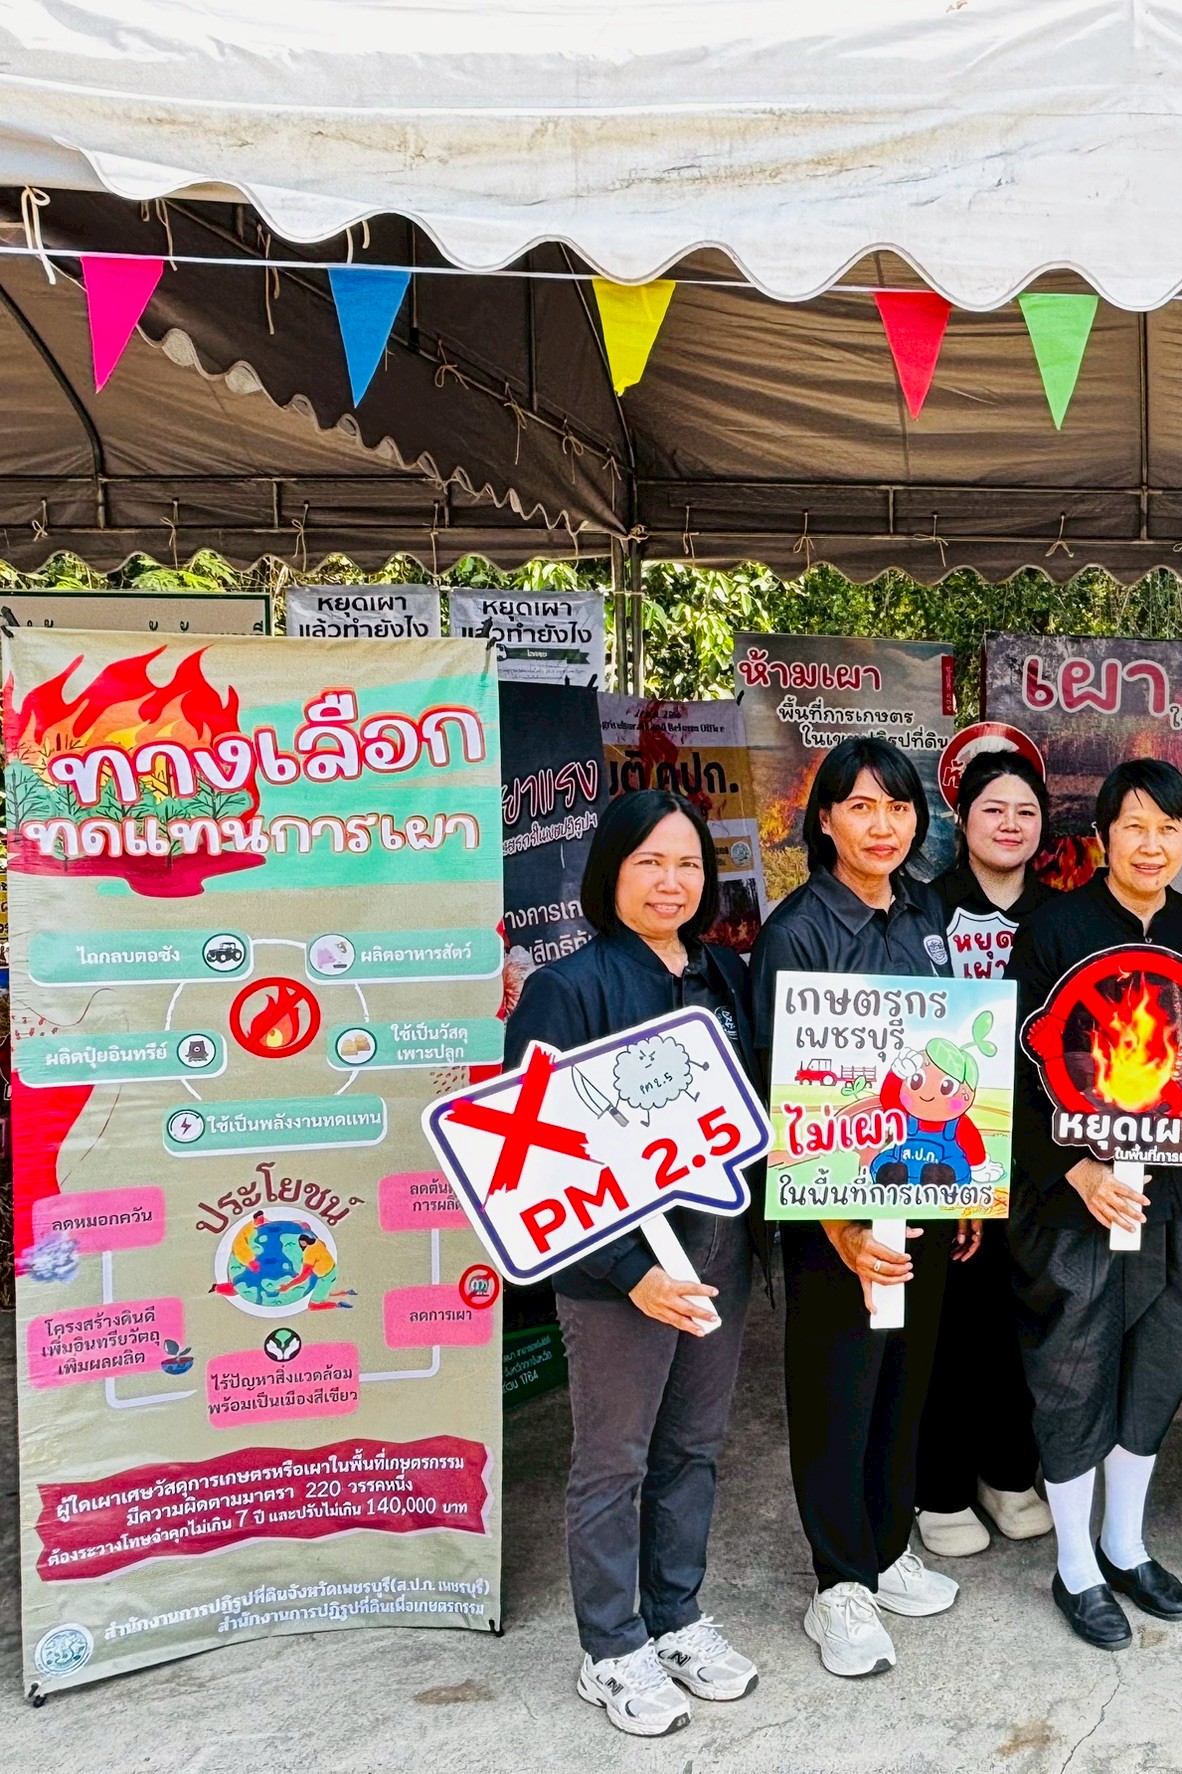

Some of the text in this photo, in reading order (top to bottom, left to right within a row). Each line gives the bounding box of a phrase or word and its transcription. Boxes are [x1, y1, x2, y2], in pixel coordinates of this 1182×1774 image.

[318, 596, 407, 619] หยุดเผา
[483, 600, 572, 622] หยุดเผา
[300, 615, 429, 637] แล้วทำยังไง
[739, 649, 881, 691] ห้ามเผา
[1023, 655, 1169, 715] เผา
[779, 697, 913, 724] พื้นที่การเกษตร
[48, 688, 486, 806] ทางเลือก
[22, 813, 480, 857] ทดแทนการเผา
[77, 945, 180, 965] ไถกลบตอซัง
[361, 942, 472, 963] ผลิตอาหารสัตว์
[785, 987, 947, 1019] เกษตรกร
[390, 1023, 468, 1044] ใช้เป็นวัสดุ
[796, 1018, 905, 1063] เพชรบุรี
[45, 1042, 168, 1069] ผลิตปุ๋ยอินทรีย์
[397, 1045, 464, 1063] เพาะปลูก
[207, 1112, 381, 1133] ใช้เป็นพลังงานทดแทน
[783, 1103, 907, 1158] ไม่เผา
[902, 1148, 939, 1163] ส.ป.ก.
[519, 1106, 741, 1254] PM 2.5
[779, 1169, 993, 1206] ในพื้นที่การเกษตร
[196, 1161, 365, 1234] ประโยชน์
[51, 1204, 152, 1233] ลดหมอกควัน
[44, 1305, 156, 1337] โครงสร้างดินดี
[410, 1310, 472, 1322] ลดการเผา
[41, 1328, 160, 1357] เพิ่มอินทรียวัตถุ
[58, 1349, 145, 1375] เพิ่มผลผลิต
[211, 1364, 353, 1391] ไร้ปัญหาสิ่งแวดล้อม
[208, 1387, 358, 1414] พร้อมเป็นเมืองสีเขียว
[56, 1448, 464, 1523] ผู้ใดเผาเศษวัสดุการเกษตรหรือเผาในพื้นที่เกษตรกรรม
[126, 1473, 413, 1526] มีความผิดตามมาตรา 220 วรรคหนึ่ง
[47, 1496, 468, 1567] ต้องระวางโทษจำคุกไม่เกิน 7 ปี และปรับไม่เกิน 140,000 บาท
